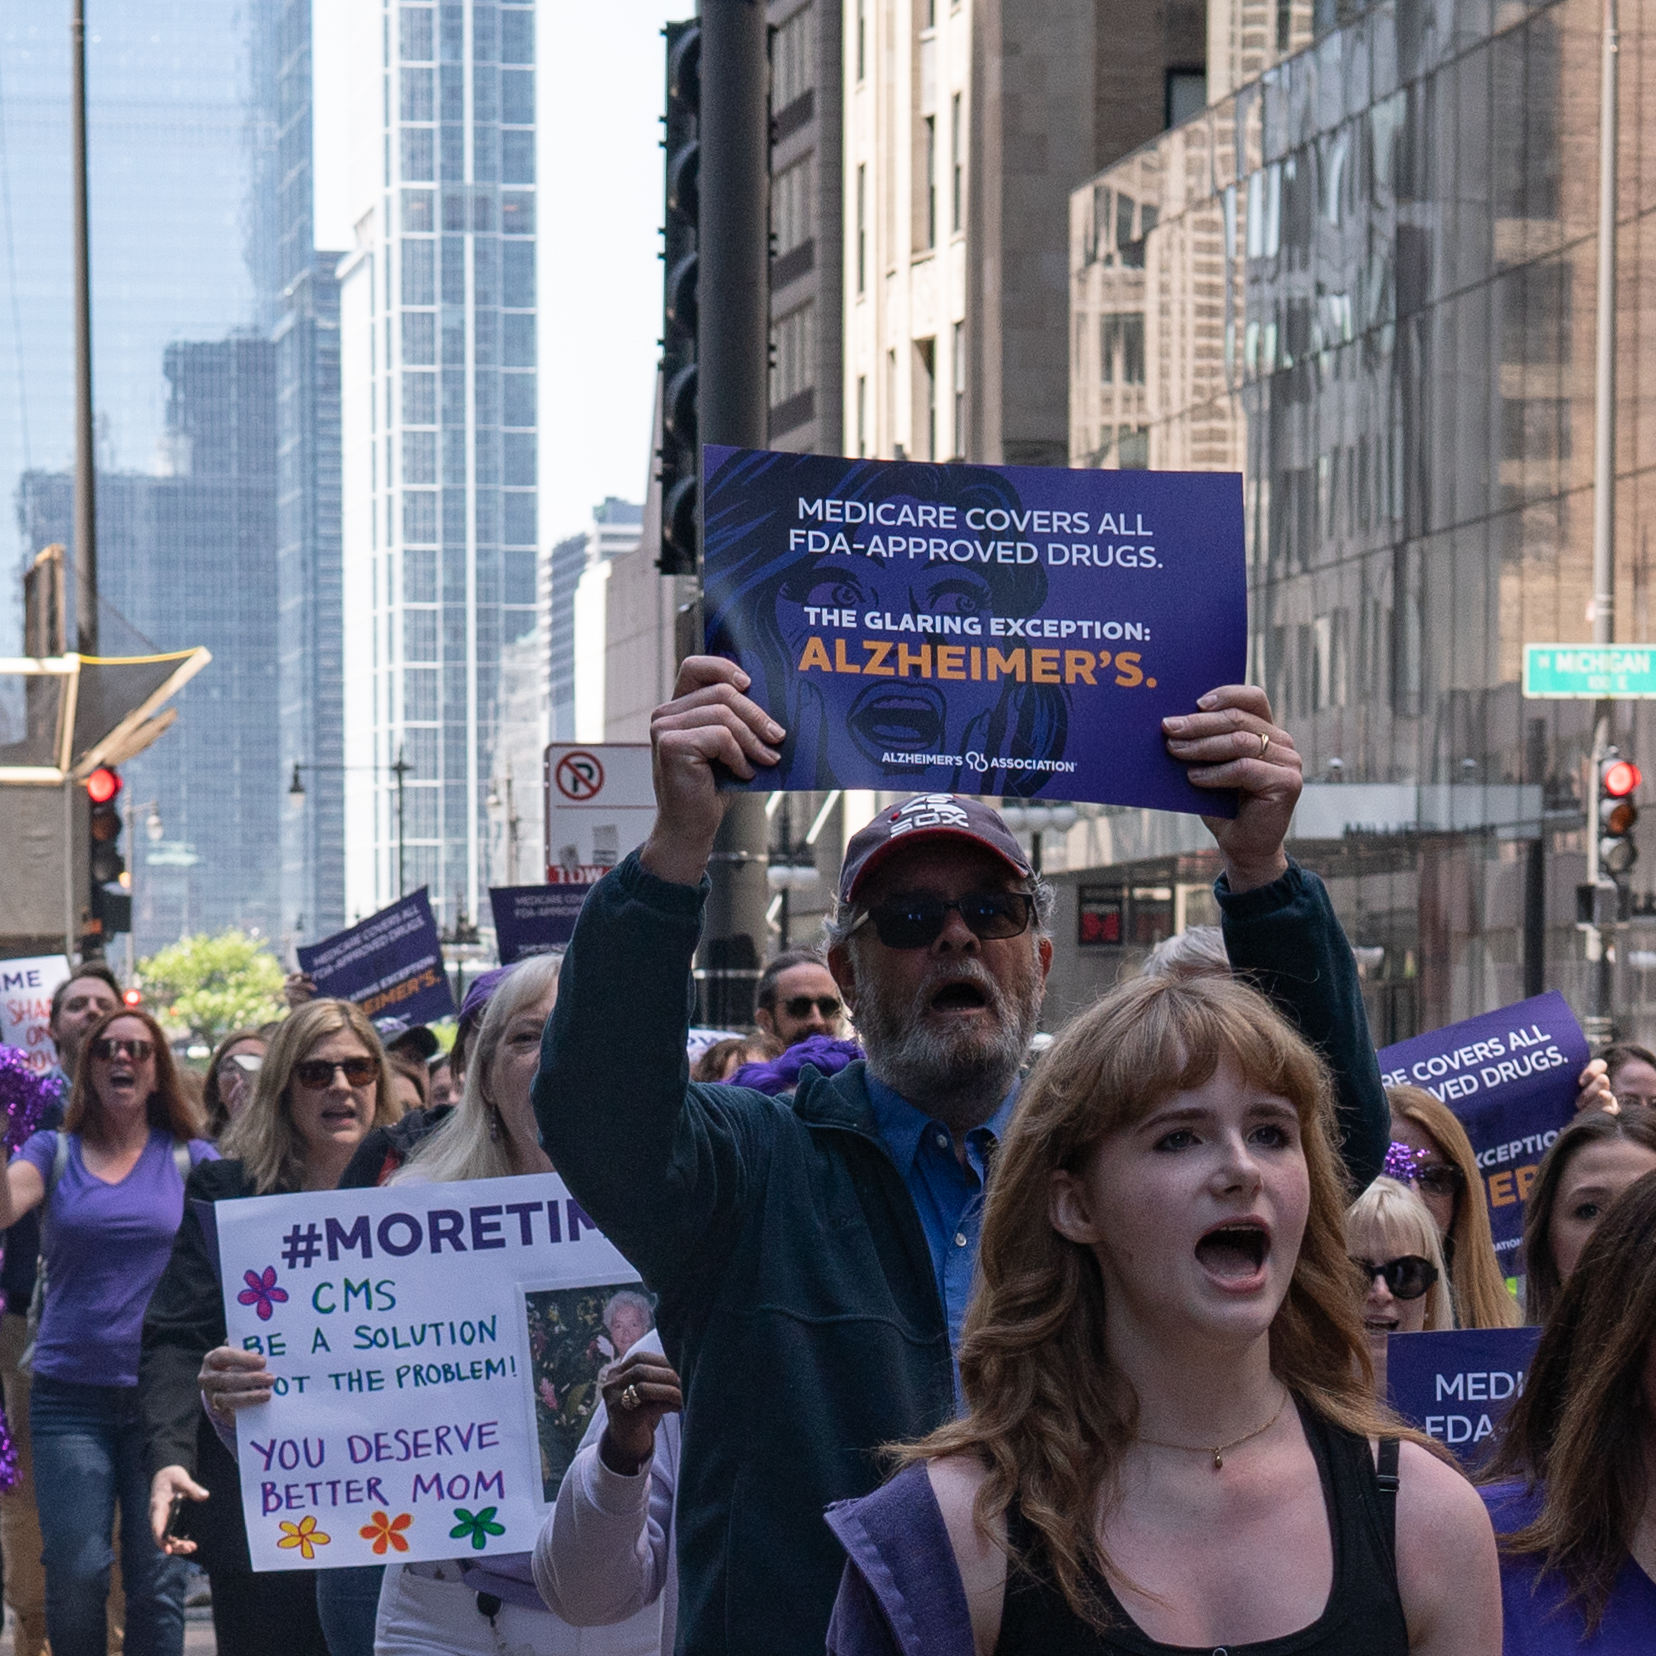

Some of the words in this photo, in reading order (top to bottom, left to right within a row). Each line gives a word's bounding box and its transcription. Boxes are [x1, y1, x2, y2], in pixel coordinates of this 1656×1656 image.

[798, 497, 957, 529] MEDICARE
[965, 507, 1090, 534] COVERS
[1098, 513, 1153, 536] ALL
[789, 529, 1039, 565] FDA-APPROVED
[1047, 543, 1163, 569] DRUGS.
[803, 607, 857, 627] THE
[864, 611, 981, 635] GLARING
[990, 618, 1151, 641] EXCEPTION:
[798, 636, 1158, 689] ALZHEIMER'S.
[1555, 652, 1650, 674] MICHIGAN
[882, 752, 963, 767] ALZHEIMER'S
[990, 758, 1076, 773] ASSOCIATION
[890, 812, 970, 838] SOX
[1412, 1038, 1505, 1080] COVERS
[1508, 1024, 1551, 1051] ALL
[1482, 1045, 1569, 1088] DRUGS.
[1475, 1128, 1565, 1169] XCEPTIO
[312, 1278, 397, 1314] CMS
[243, 1333, 287, 1356] BE
[311, 1327, 332, 1354] A
[353, 1315, 497, 1350] SOLUTION
[273, 1376, 311, 1396] OT
[328, 1369, 386, 1393] THE
[395, 1355, 518, 1389] PROBLEM!
[249, 1437, 325, 1471] YOU
[346, 1421, 500, 1464] DESERVE
[261, 1477, 390, 1517] BETTER
[411, 1470, 505, 1503] MOM
